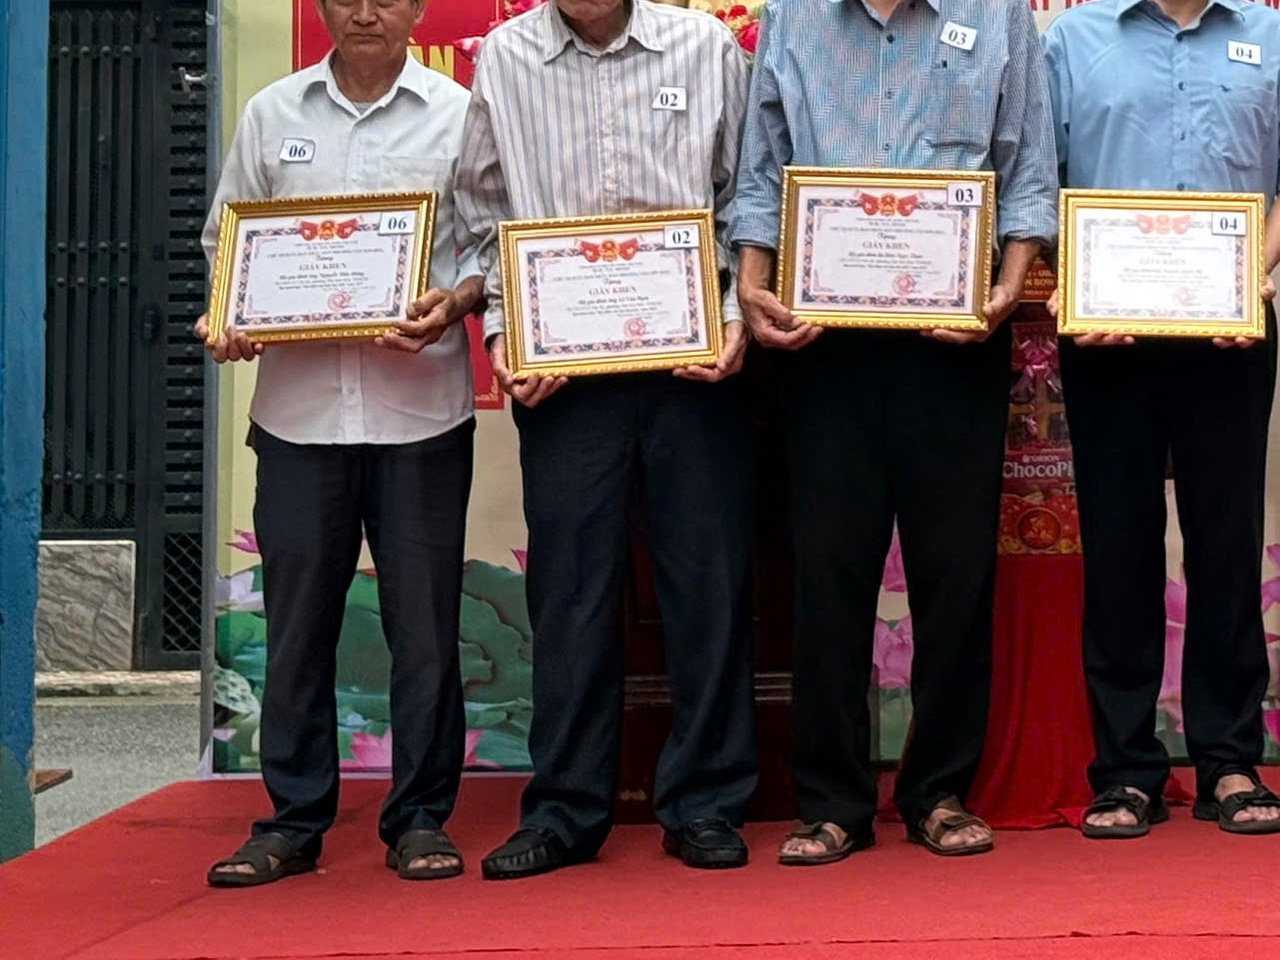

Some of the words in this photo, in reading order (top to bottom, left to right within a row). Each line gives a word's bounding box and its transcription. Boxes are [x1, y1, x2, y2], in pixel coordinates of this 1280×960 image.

[948, 29, 967, 45] 03
[1236, 46, 1253, 59] 04
[660, 92, 678, 107] 02
[289, 144, 307, 158] 06
[954, 188, 975, 203] 03
[387, 216, 408, 231] 06
[1219, 217, 1238, 231] 04
[672, 230, 692, 245] 02
